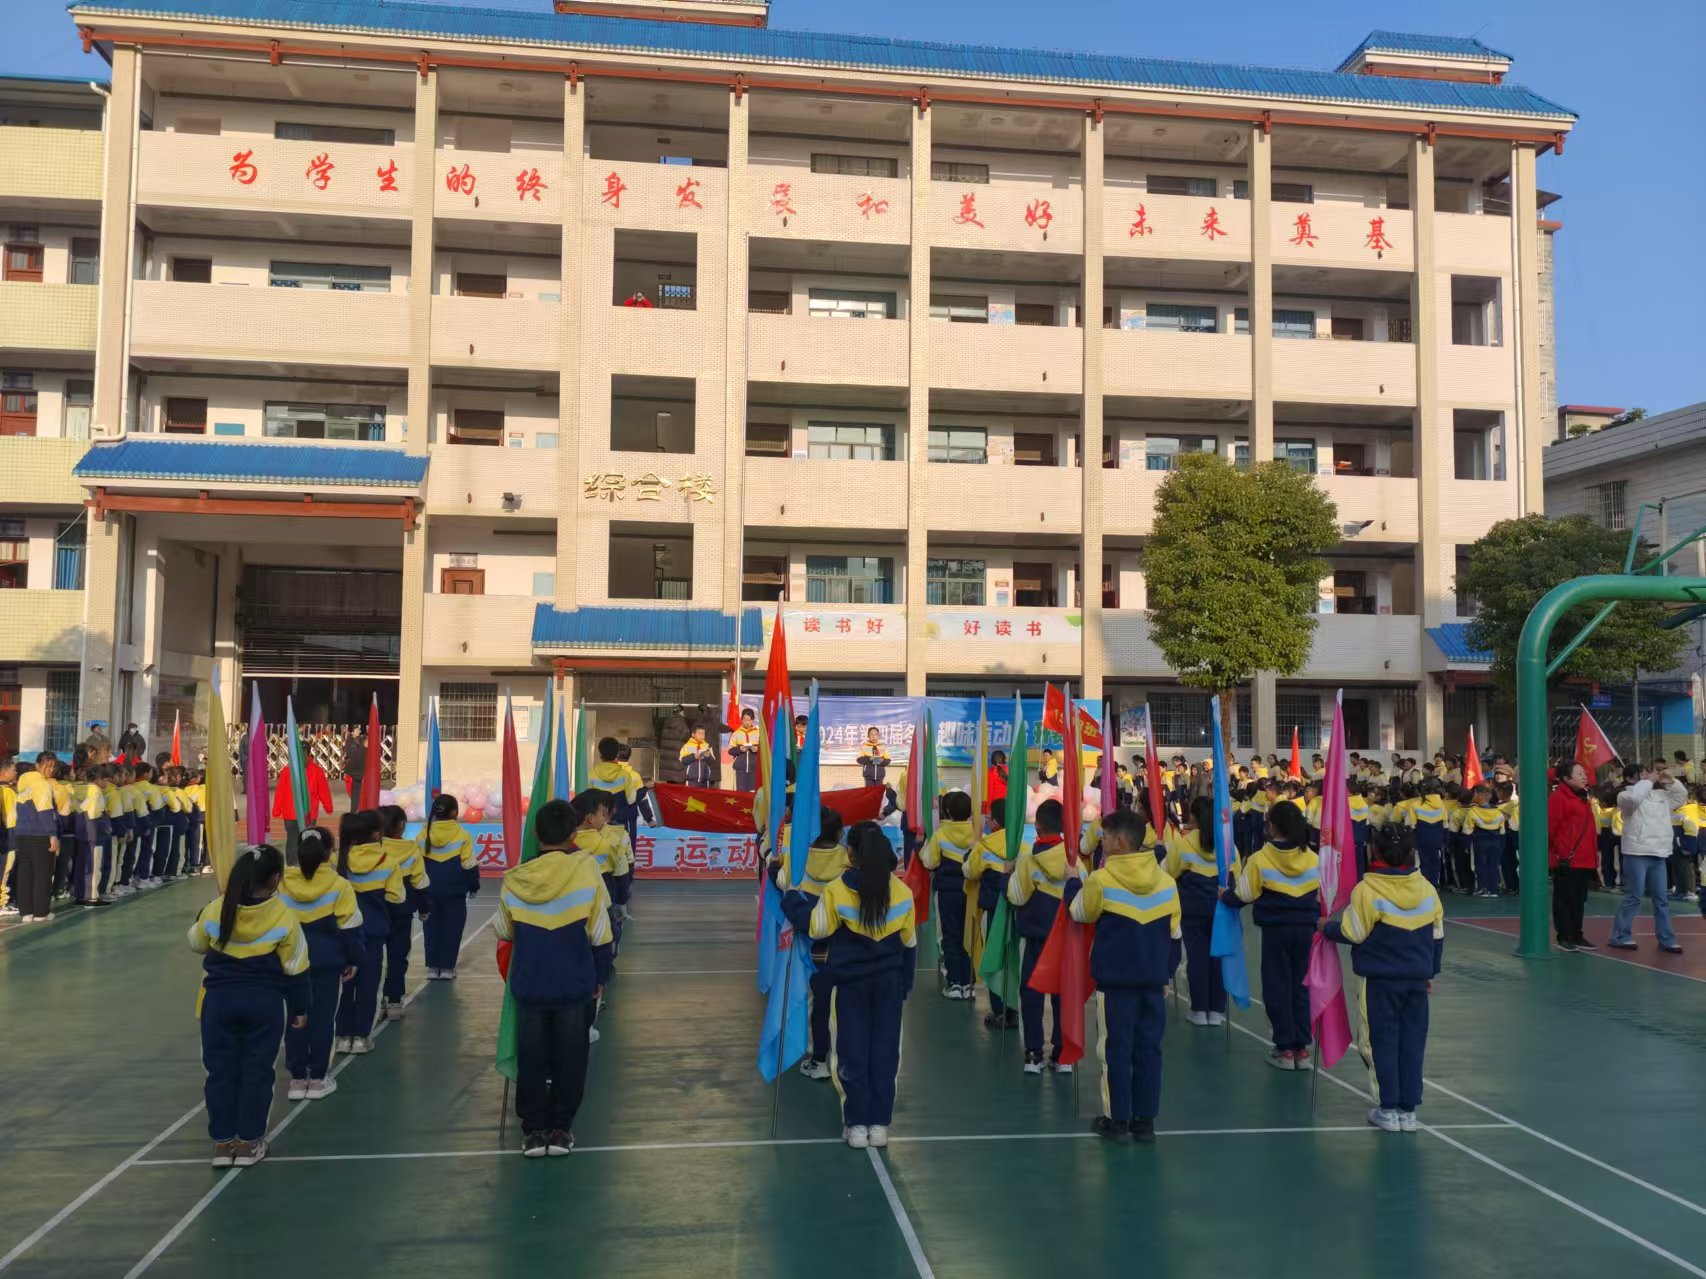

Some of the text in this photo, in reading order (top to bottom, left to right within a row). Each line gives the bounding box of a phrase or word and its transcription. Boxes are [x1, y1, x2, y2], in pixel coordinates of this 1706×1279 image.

[584, 472, 717, 504] 综合楼
[803, 616, 885, 634] 读书好
[963, 619, 1043, 637] 好读书
